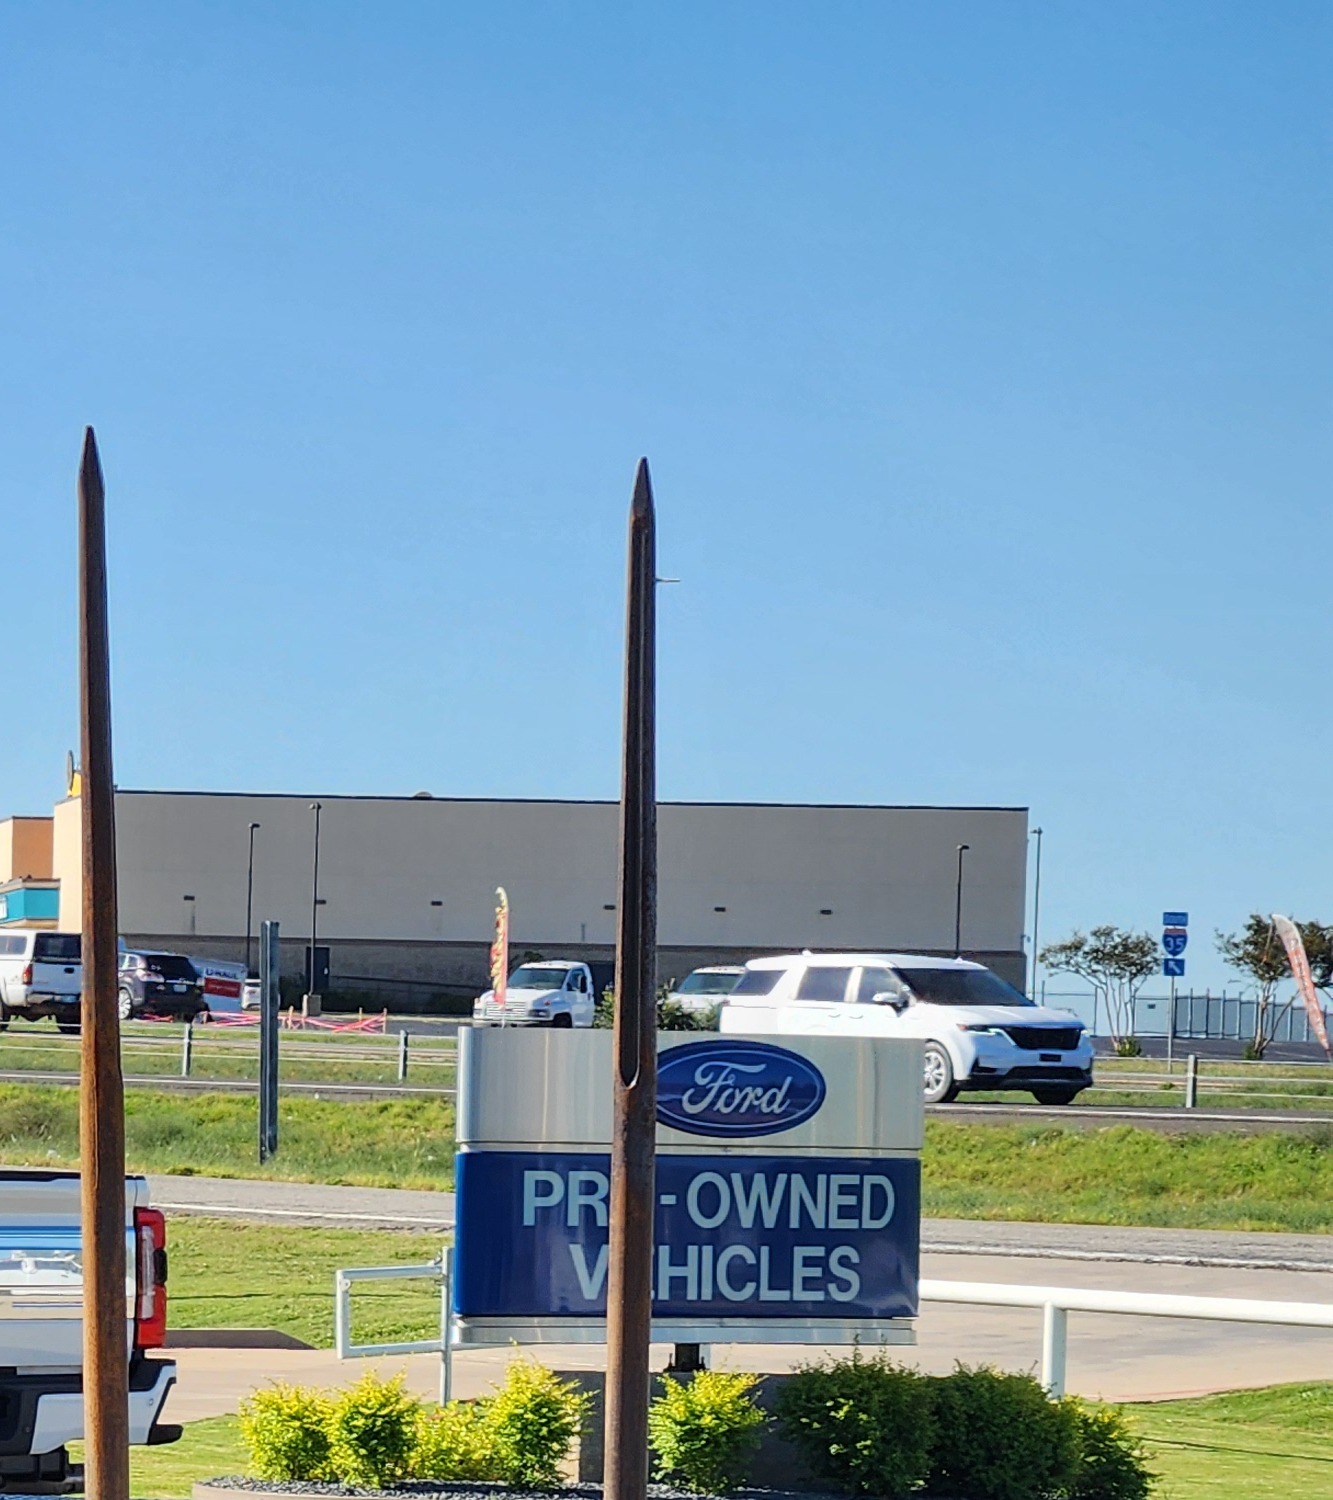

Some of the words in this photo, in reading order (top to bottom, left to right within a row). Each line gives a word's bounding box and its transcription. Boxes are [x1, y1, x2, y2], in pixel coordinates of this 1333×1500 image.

[1165, 937, 1185, 952] 35
[680, 1061, 794, 1115] Ford
[522, 1169, 896, 1230] PR-OWNED
[569, 1244, 861, 1303] VHICLES
